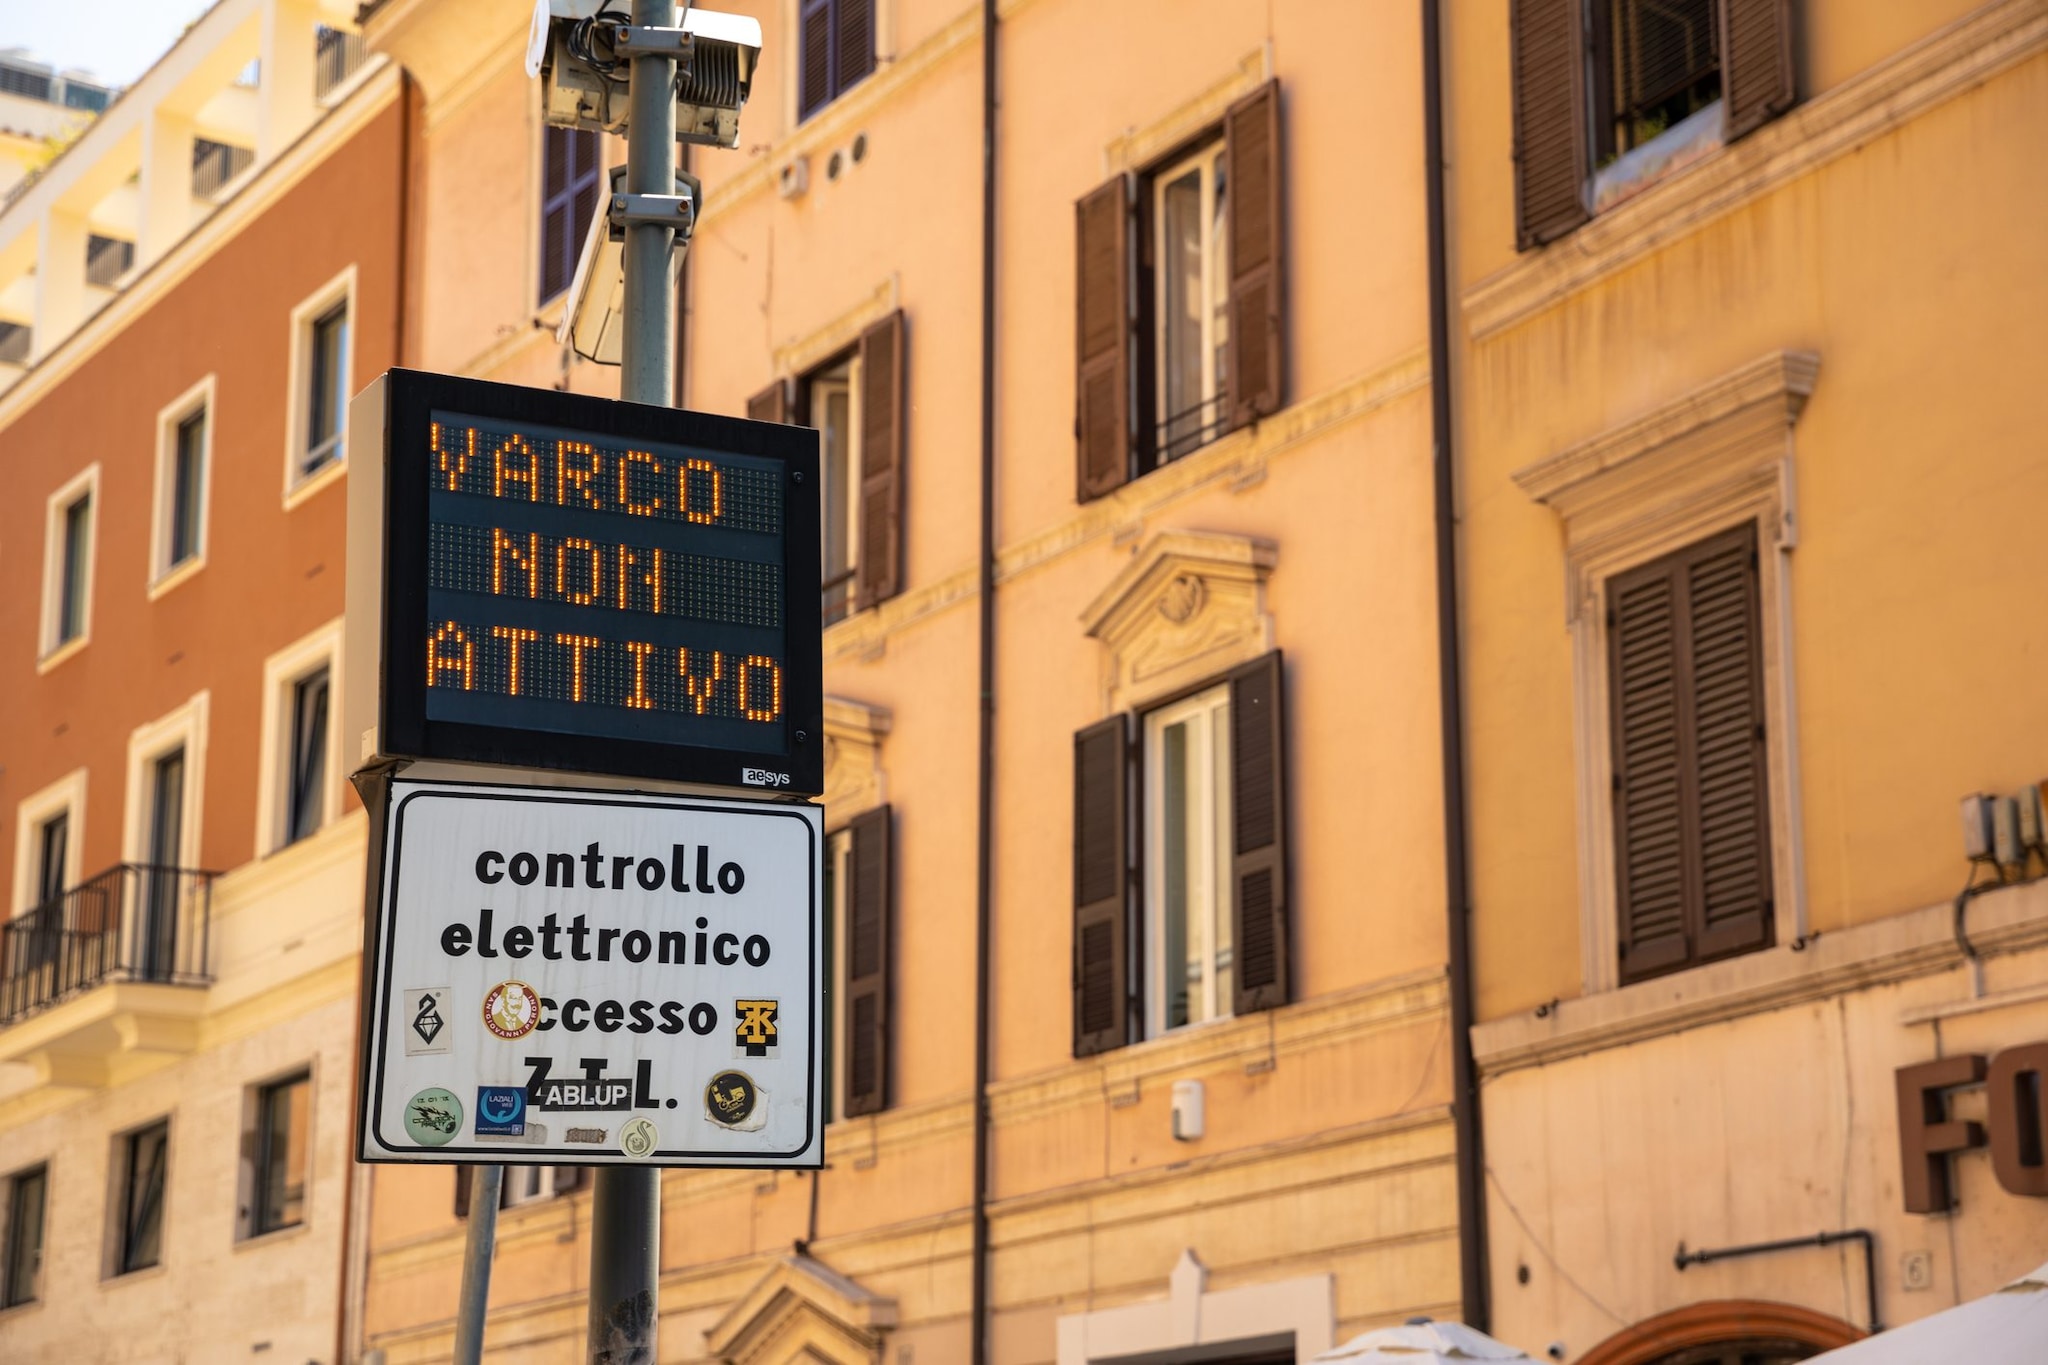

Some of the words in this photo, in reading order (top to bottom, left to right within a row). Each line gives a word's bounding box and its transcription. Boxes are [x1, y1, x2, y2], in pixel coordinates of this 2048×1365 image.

[430, 421, 721, 525] VARCO
[493, 527, 662, 614] NON
[427, 620, 782, 722] ATTIVO
[747, 770, 790, 786] aesys
[475, 841, 745, 895] controllo
[440, 909, 771, 968] elettronico
[535, 997, 718, 1036] ccesso
[545, 1085, 628, 1106] ABLUP
